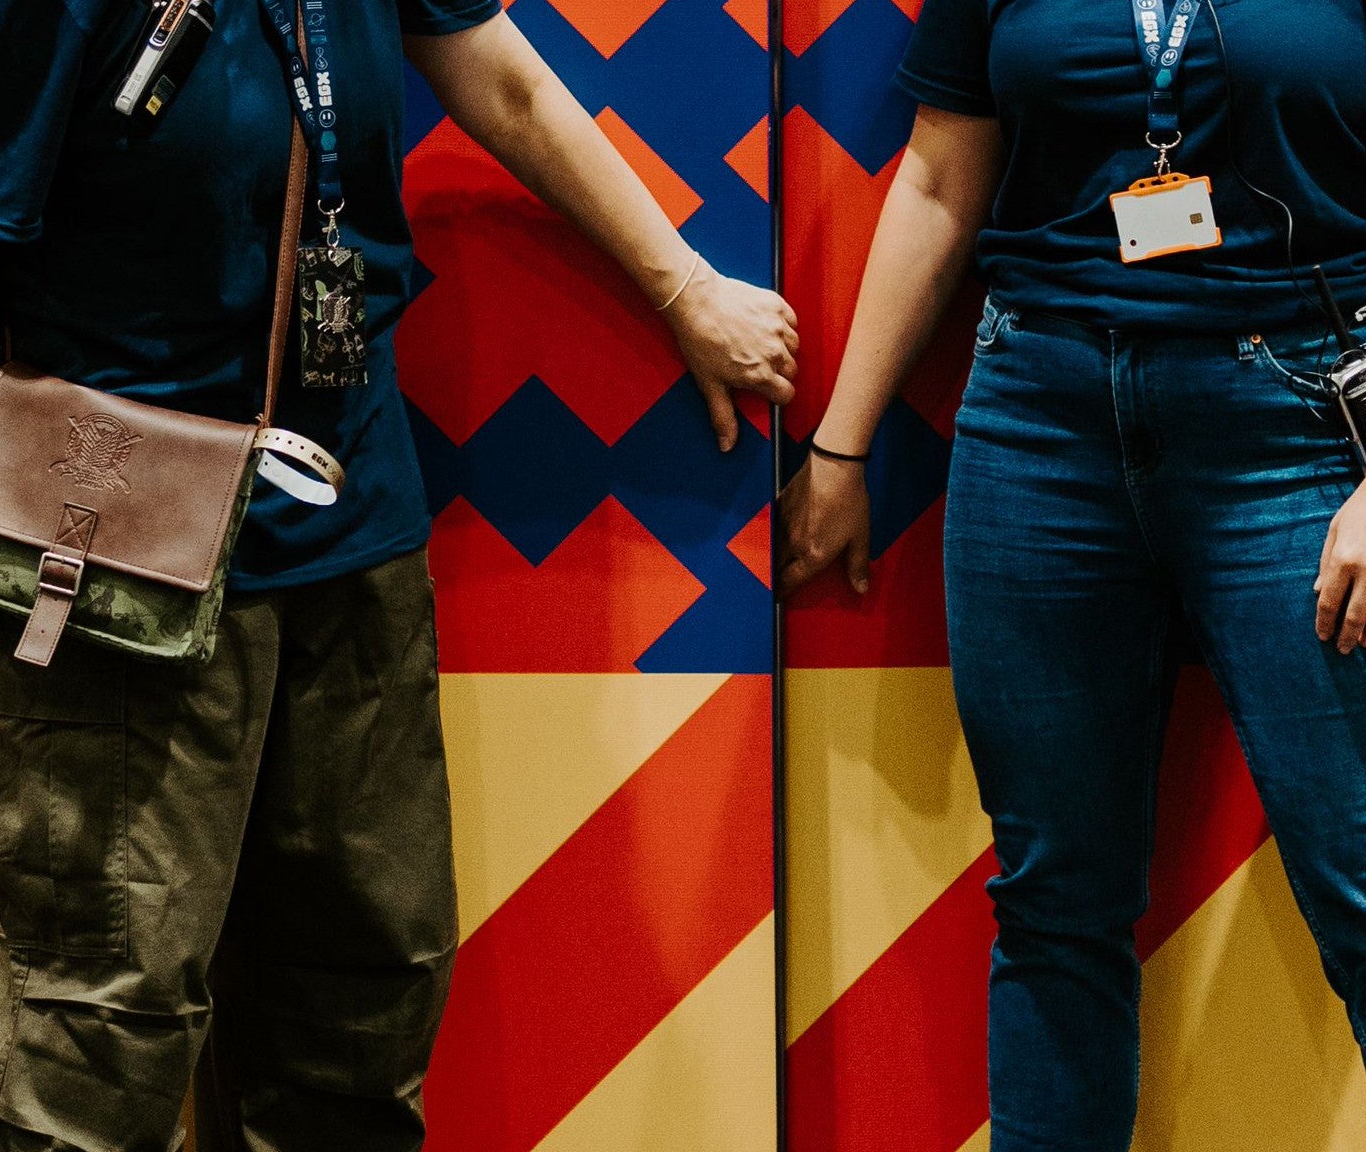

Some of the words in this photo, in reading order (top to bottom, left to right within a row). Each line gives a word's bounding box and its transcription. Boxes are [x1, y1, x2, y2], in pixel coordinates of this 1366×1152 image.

[1141, 10, 1160, 44] EGX
[1167, 14, 1189, 48] EGX
[293, 76, 313, 111] EGX
[316, 71, 333, 107] EGX
[311, 452, 329, 469] EGX
